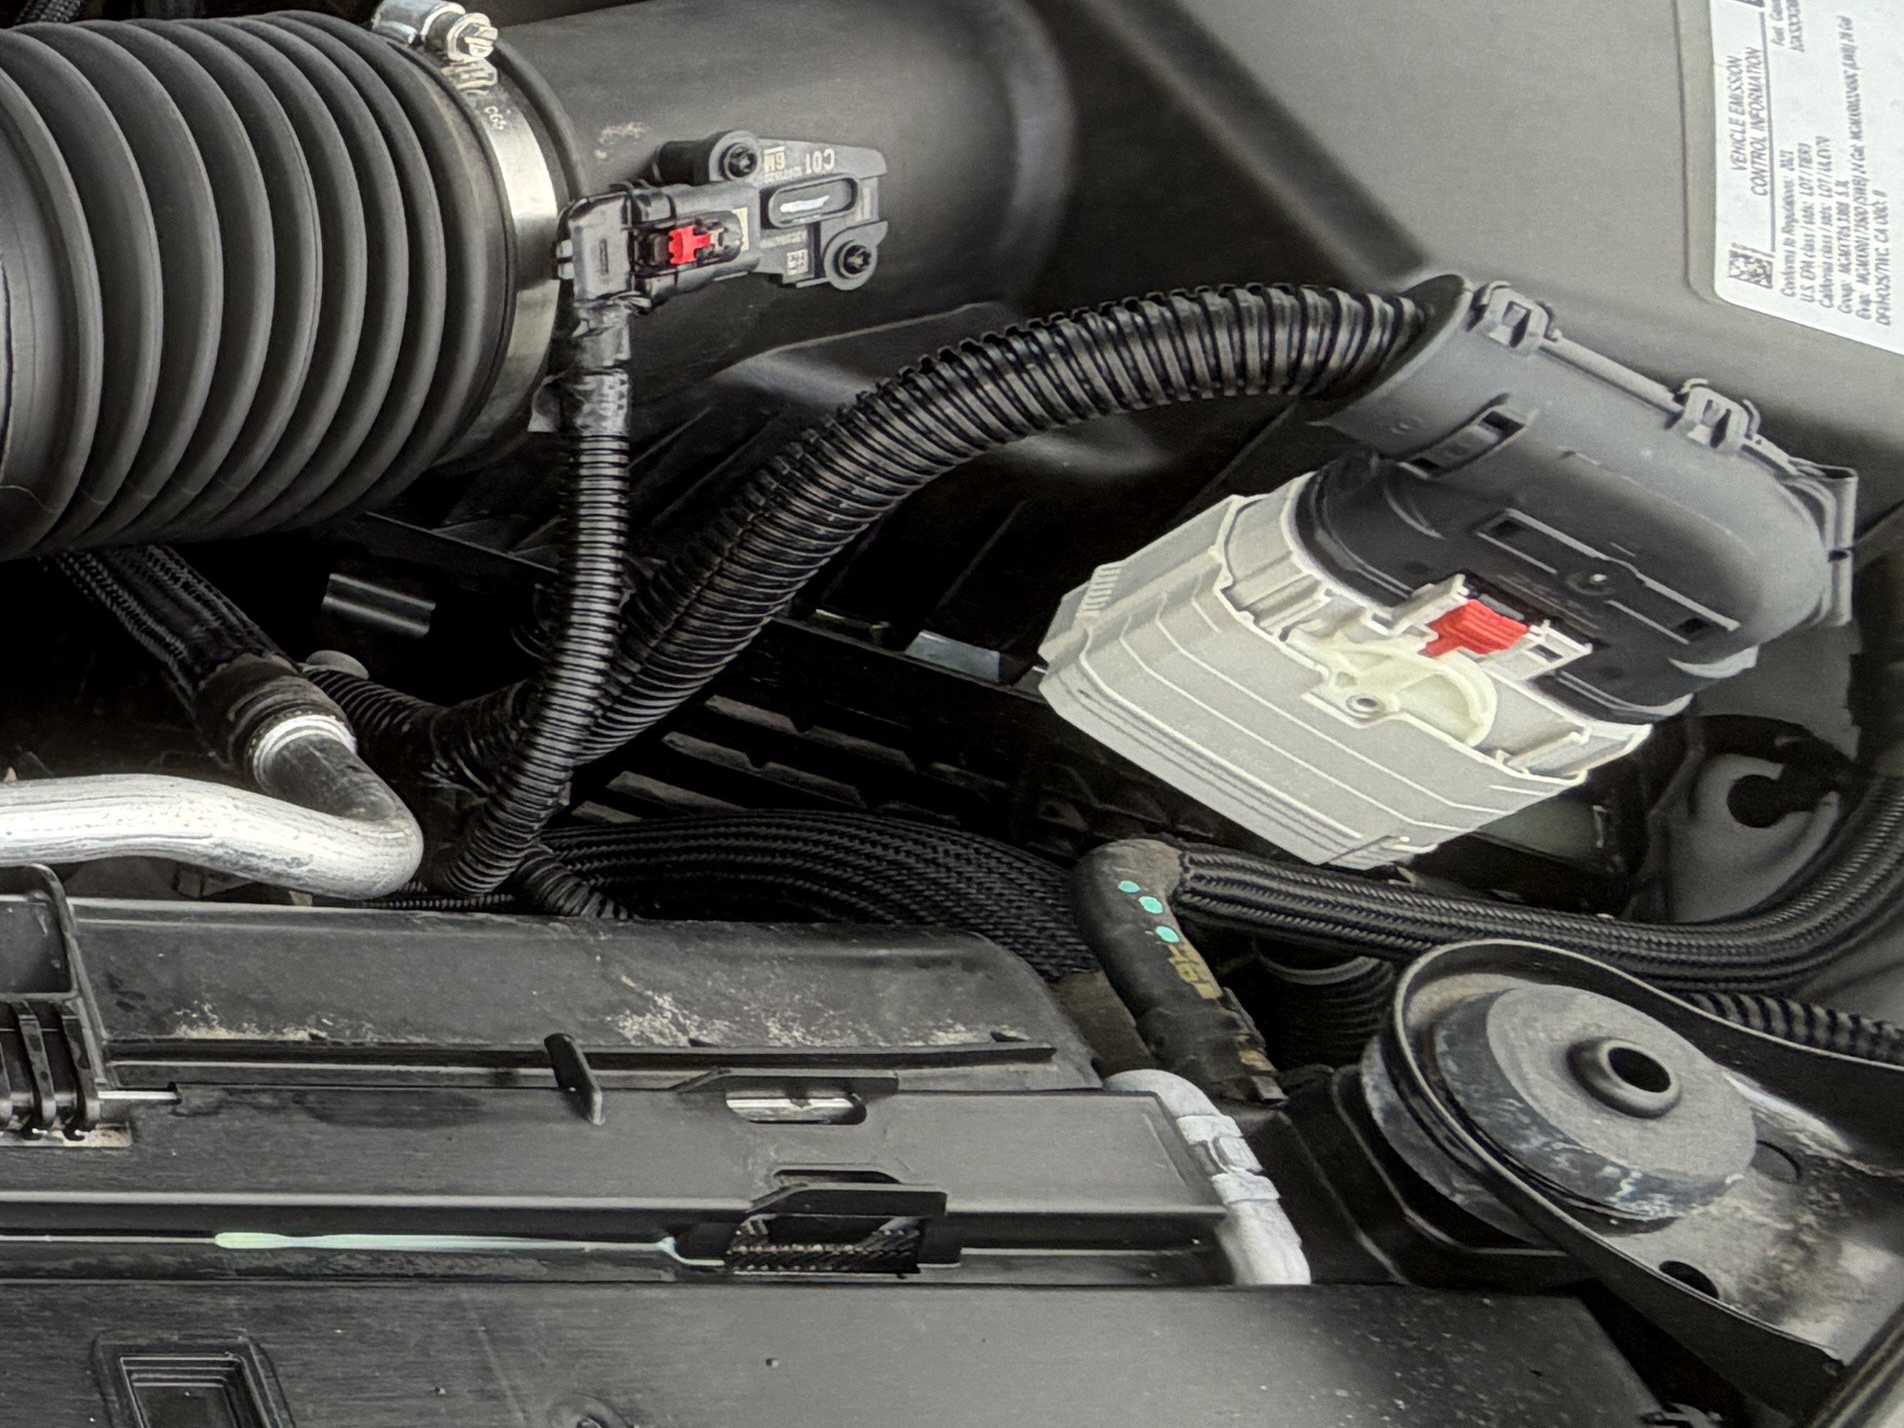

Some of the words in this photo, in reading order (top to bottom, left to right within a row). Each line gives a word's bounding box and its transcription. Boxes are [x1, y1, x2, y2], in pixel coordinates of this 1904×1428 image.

[1727, 56, 1744, 114] EMISSION
[1746, 47, 1764, 129] INFORMATION
[1730, 117, 1746, 171] VEHICLE
[1749, 133, 1768, 195] CONTROL
